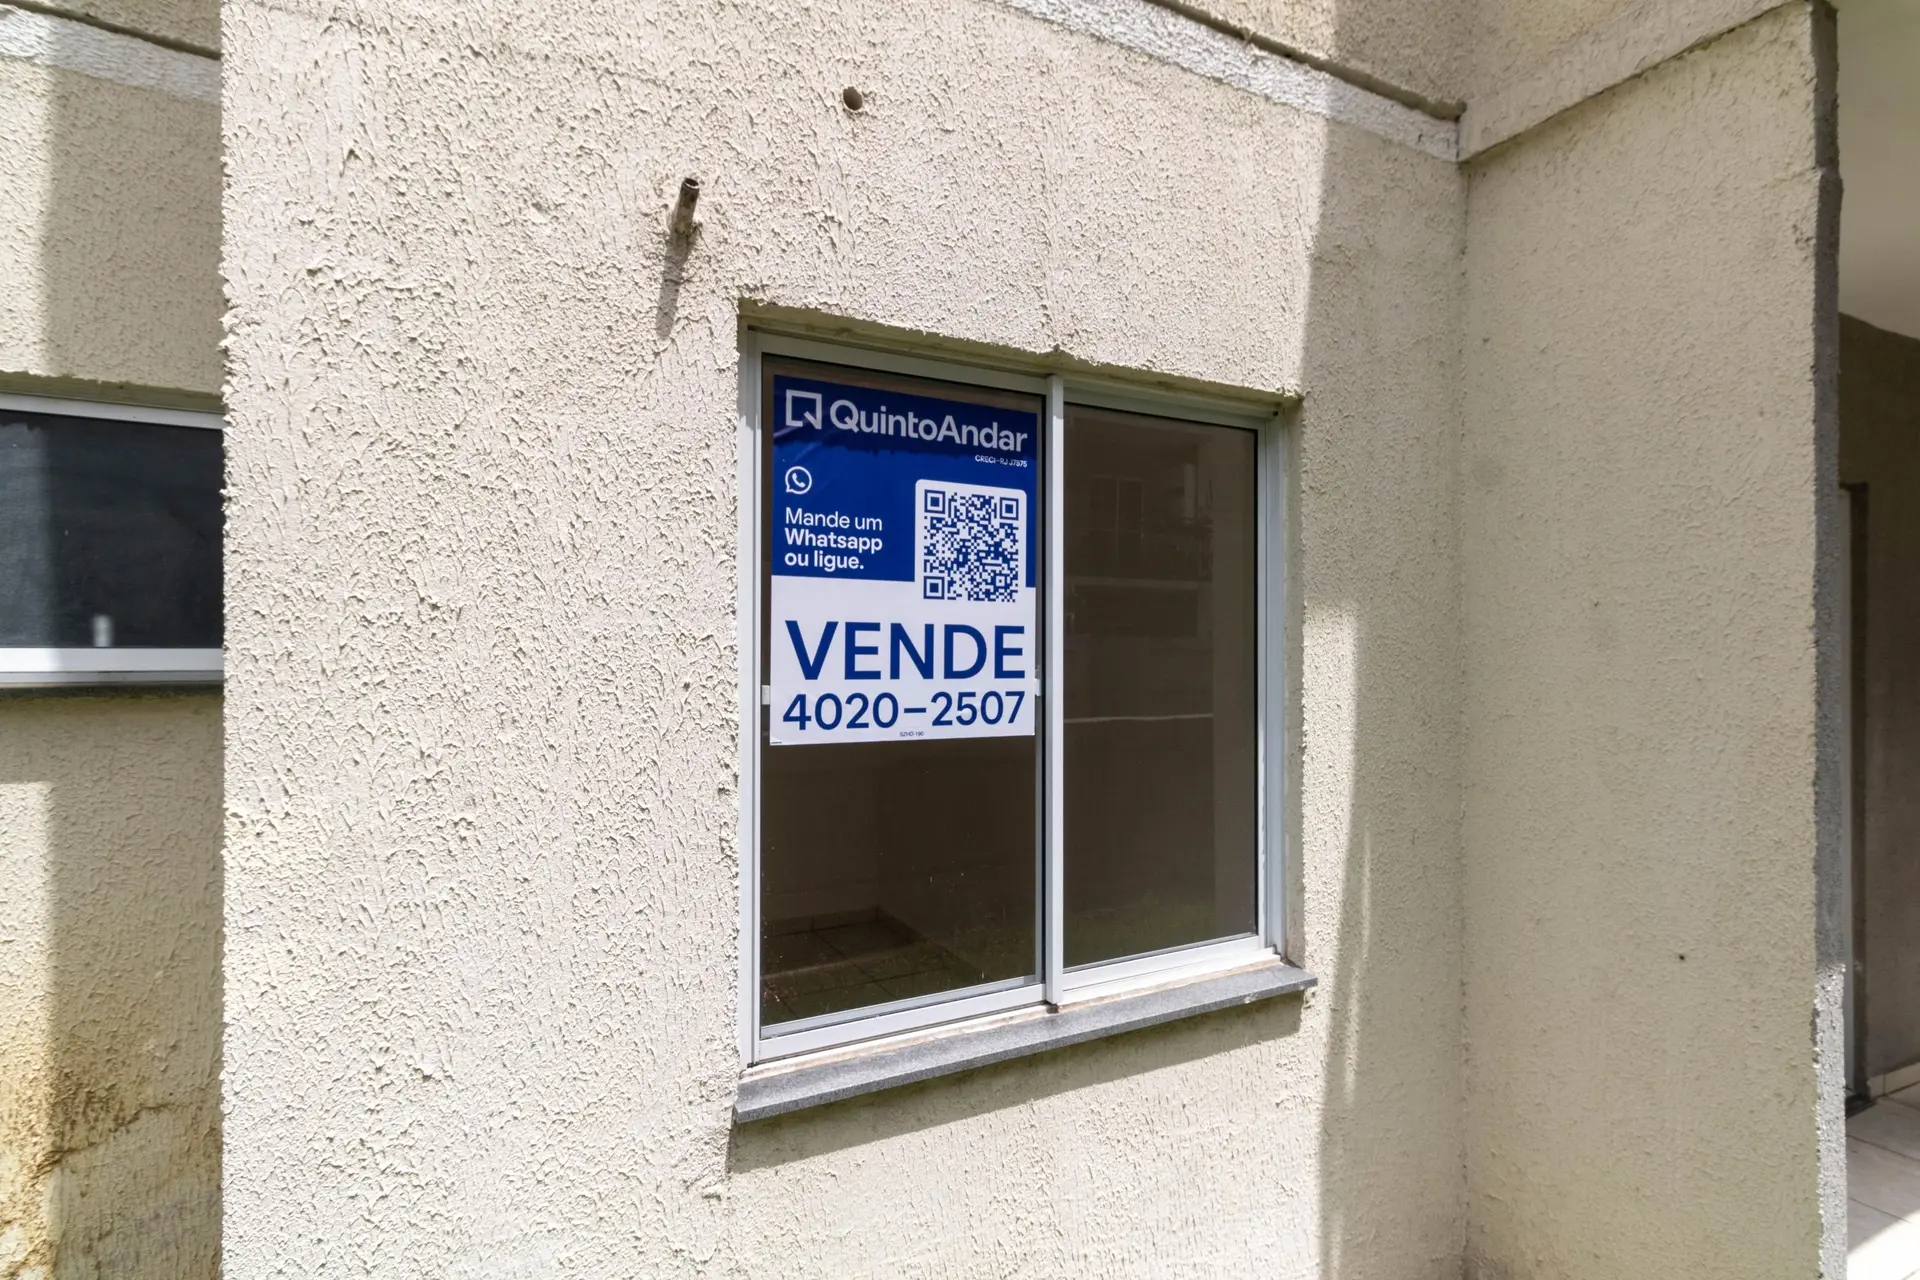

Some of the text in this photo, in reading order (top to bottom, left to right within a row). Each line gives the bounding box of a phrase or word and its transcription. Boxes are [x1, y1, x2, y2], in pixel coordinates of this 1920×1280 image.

[829, 399, 1028, 452] QuintoAndar
[974, 454, 1009, 465] CRECI-RJ
[785, 507, 883, 531] Mande um
[784, 527, 883, 554] Whatsapp
[784, 550, 865, 572] ou ligue.
[784, 620, 1026, 680] VENDE
[782, 690, 1026, 730] 4020-2507
